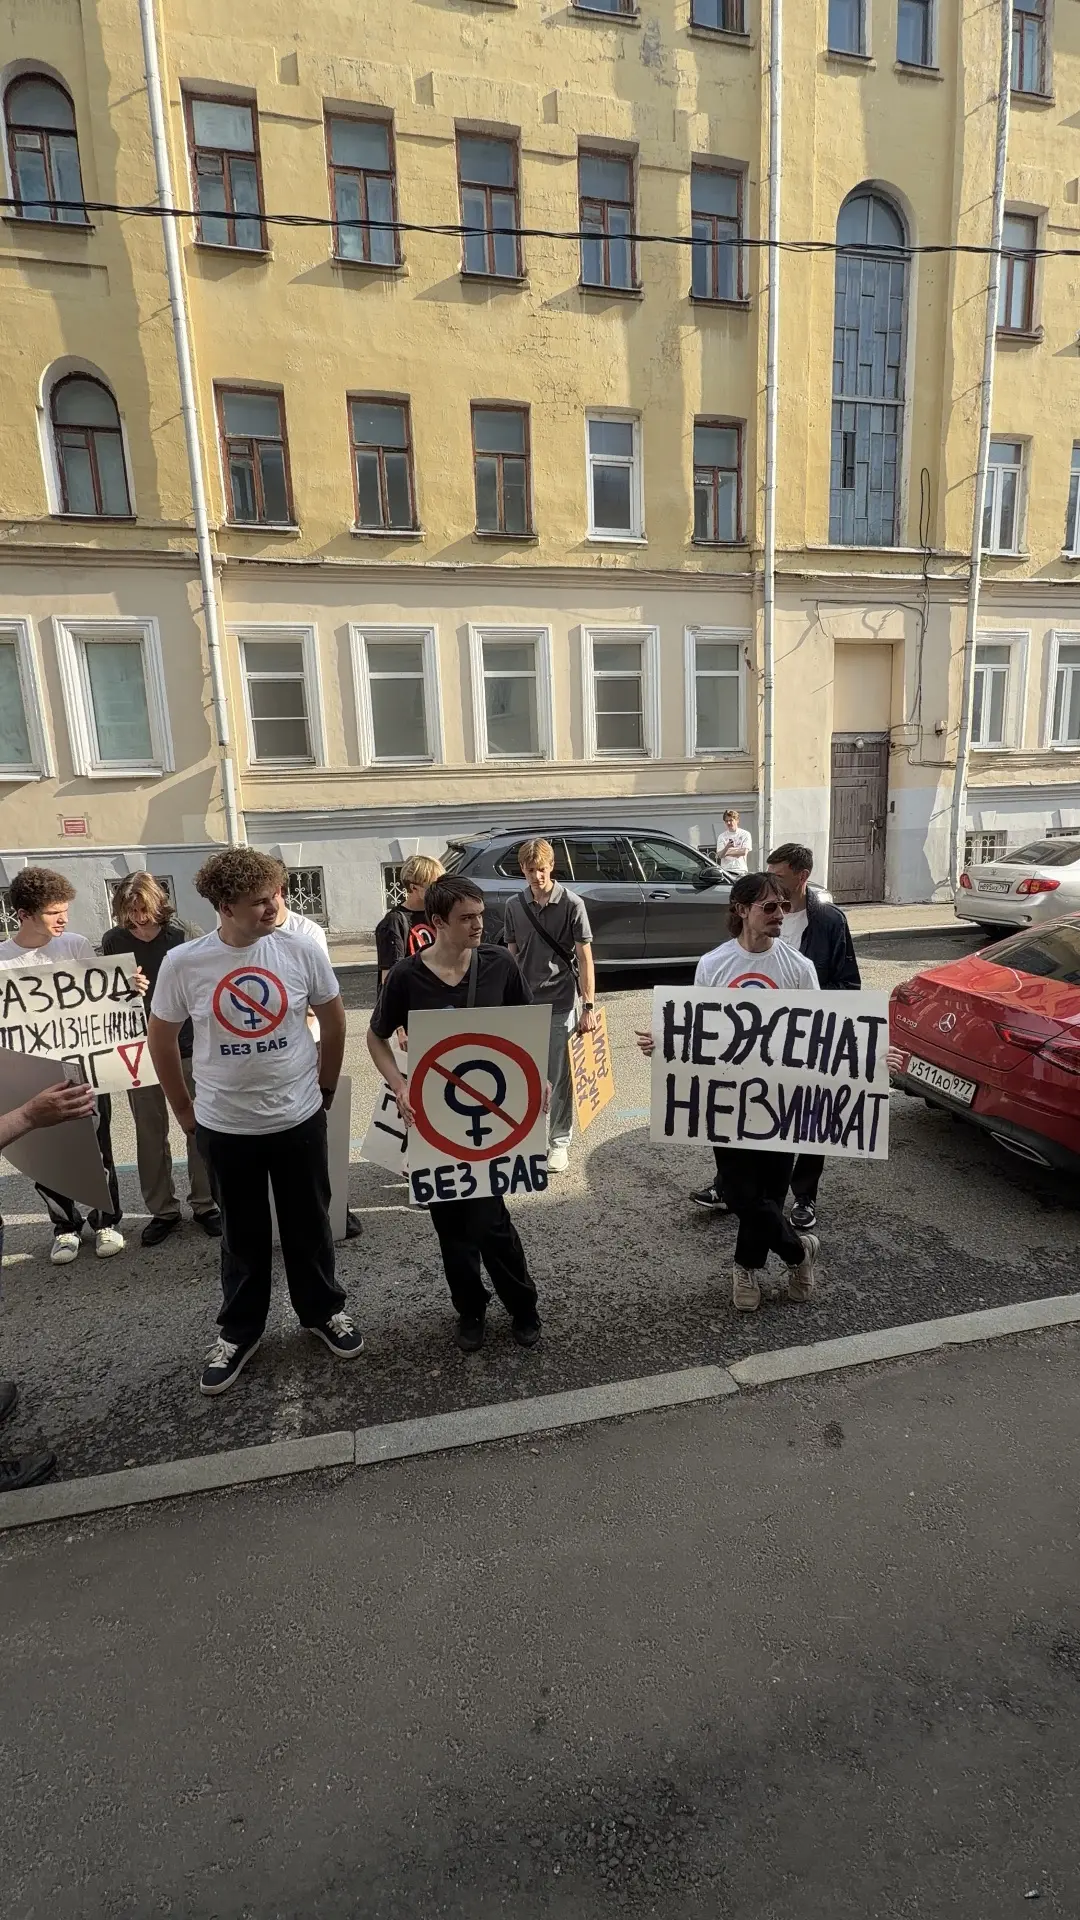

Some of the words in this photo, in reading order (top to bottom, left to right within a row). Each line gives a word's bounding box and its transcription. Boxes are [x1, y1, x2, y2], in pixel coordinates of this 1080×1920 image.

[0, 966, 139, 1019] АЗВОД
[220, 1043, 252, 1056] БЕЗ
[256, 1037, 288, 1053] БАБ
[587, 1070, 600, 1111] НАС
[411, 1162, 477, 1202] БЕЗ
[489, 1154, 548, 1196] БАБ
